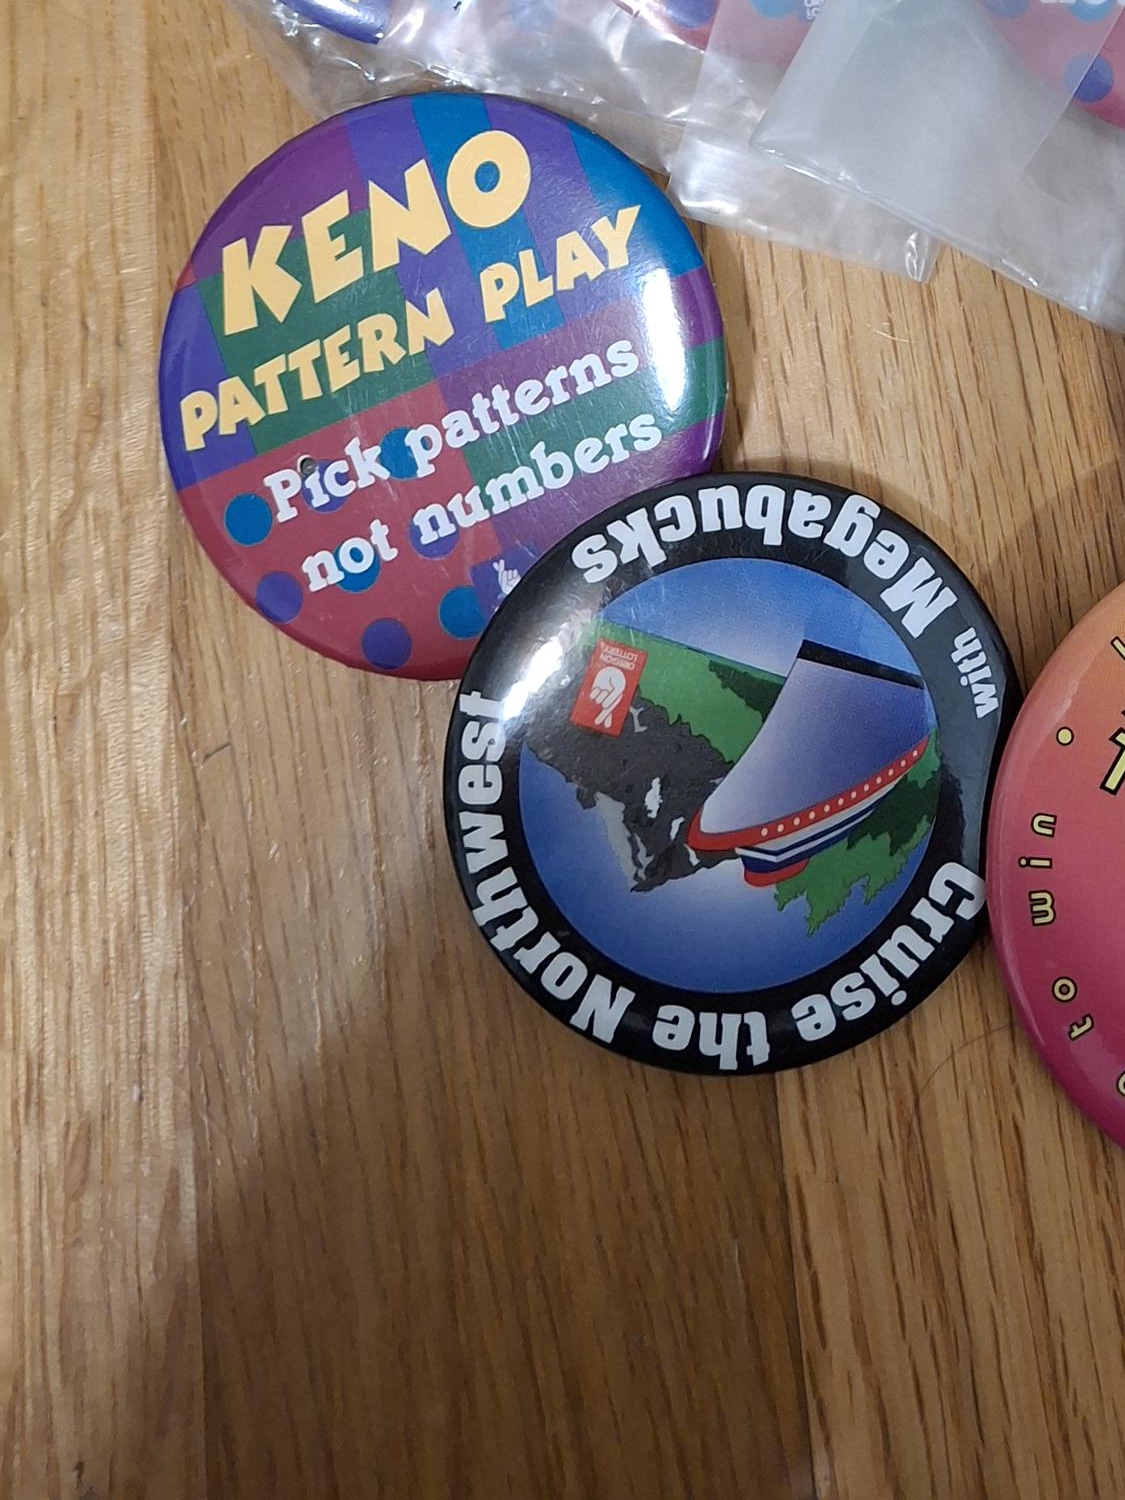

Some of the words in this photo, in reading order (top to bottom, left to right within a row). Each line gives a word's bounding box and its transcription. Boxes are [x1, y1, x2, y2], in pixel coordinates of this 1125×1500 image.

[222, 129, 532, 336] KENO
[179, 289, 455, 453] PATTERN
[478, 204, 642, 323] PLAY
[263, 435, 394, 523] Pick
[403, 337, 640, 480] patterns
[301, 516, 399, 594] not
[411, 412, 664, 544] numbers
[570, 482, 959, 640] Megabucks
[949, 625, 1000, 720] with
[458, 689, 634, 1045] Northwest
[790, 860, 987, 1045] Cruise
[1017, 811, 1059, 929] win
[652, 1003, 772, 1071] the
[1051, 975, 1096, 1042] to
